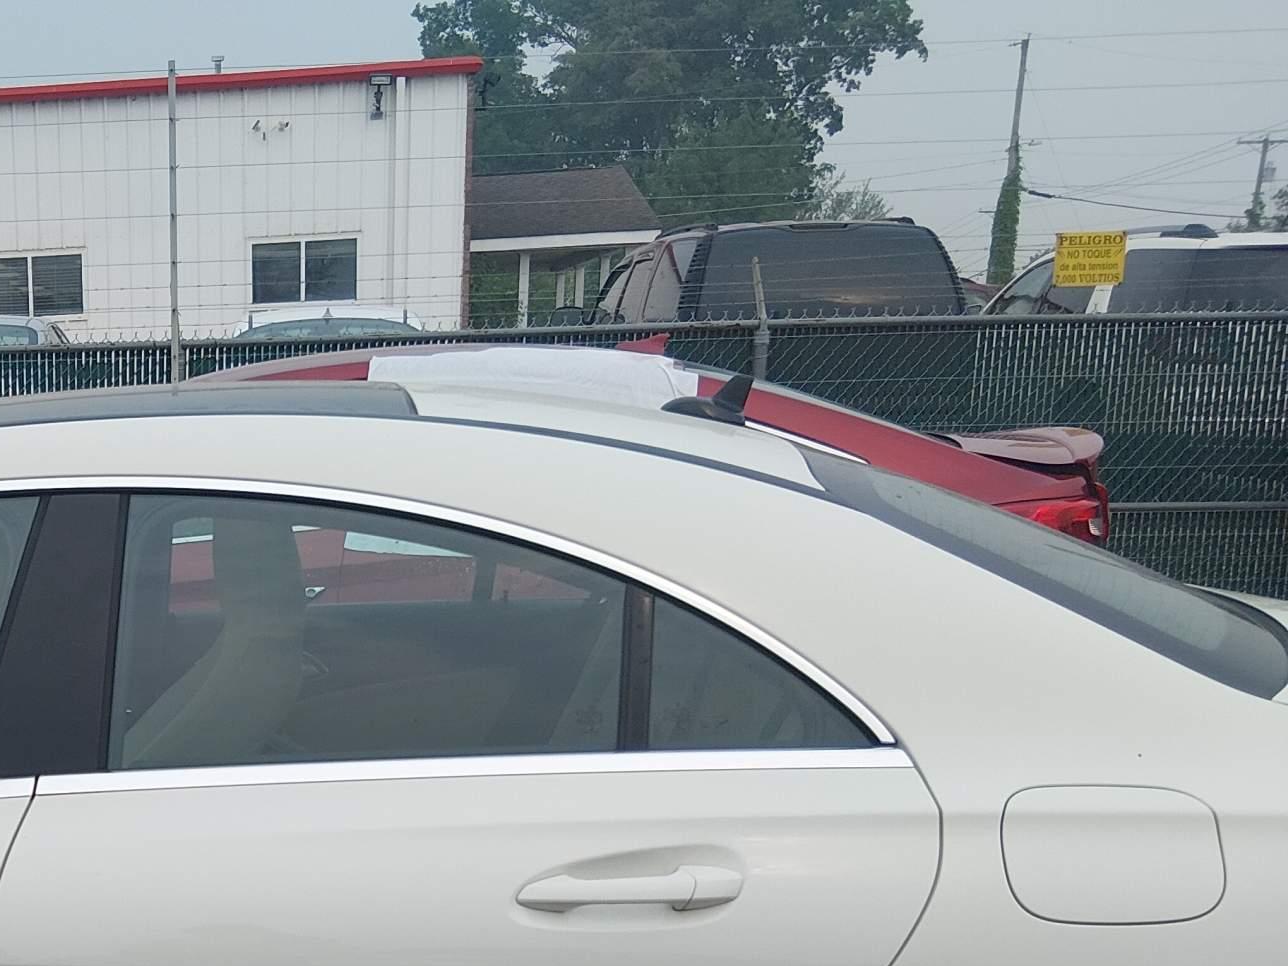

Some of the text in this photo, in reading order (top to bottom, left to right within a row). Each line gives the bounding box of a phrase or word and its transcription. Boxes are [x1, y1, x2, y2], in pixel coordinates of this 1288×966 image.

[1060, 235, 1123, 246] PELIGRO
[1067, 249, 1112, 259] NO TOQUE
[1059, 263, 1070, 271] de
[1072, 262, 1086, 271] alta
[1079, 273, 1120, 283] VOLTIOS
